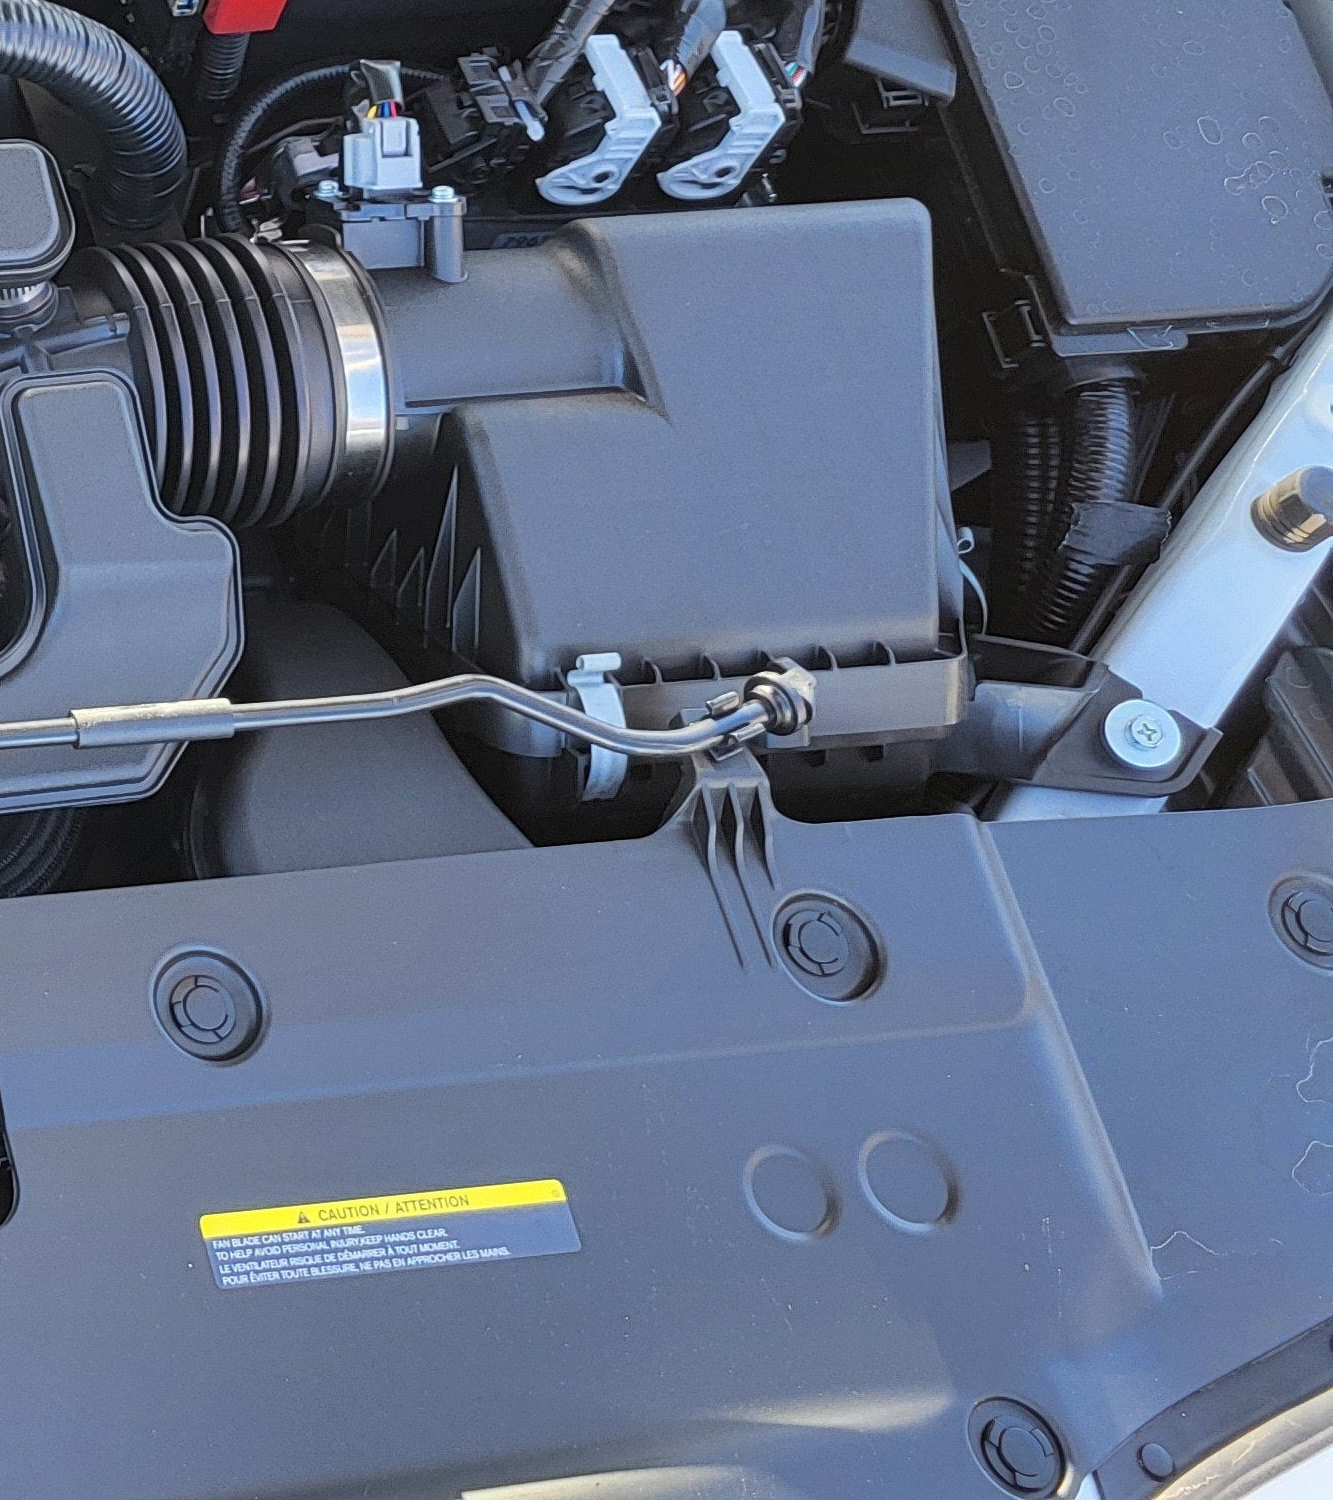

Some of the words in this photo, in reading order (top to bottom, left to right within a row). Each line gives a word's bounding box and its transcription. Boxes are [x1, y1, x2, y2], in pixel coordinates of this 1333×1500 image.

[317, 1204, 380, 1222] CAUTION
[385, 1204, 389, 1213] /
[396, 1195, 470, 1213] ATTENTION
[213, 1240, 230, 1249] FAN
[232, 1237, 261, 1247] BLADE
[262, 1234, 281, 1244] CAN
[283, 1231, 309, 1242] START
[311, 1229, 322, 1238] AT
[324, 1227, 341, 1237] ANY
[215, 1252, 229, 1260] TO
[230, 1250, 252, 1259] HELP
[255, 1246, 281, 1257] AVOID
[283, 1241, 329, 1253] PERSONAL
[384, 1232, 416, 1243] HANDS
[416, 1228, 449, 1239] CLEAR.
[219, 1264, 231, 1274] LE
[232, 1258, 288, 1272] VENTILATEUR
[290, 1254, 323, 1265] RISQUE
[324, 1253, 337, 1262] DE
[337, 1247, 386, 1262] DÉMARRER
[395, 1244, 419, 1254] TOUT
[419, 1240, 460, 1252] MOMENT.
[222, 1274, 249, 1285] POUR
[250, 1269, 280, 1283] ÉVITER
[281, 1267, 310, 1279] TOUTE
[311, 1262, 359, 1276] BLESSURE,
[359, 1261, 373, 1270] NE
[374, 1259, 392, 1269] PAS
[393, 1257, 406, 1267] EN
[407, 1251, 462, 1266] APPROCHER
[463, 1250, 480, 1259] LES
[480, 1246, 511, 1258] MAINS.
